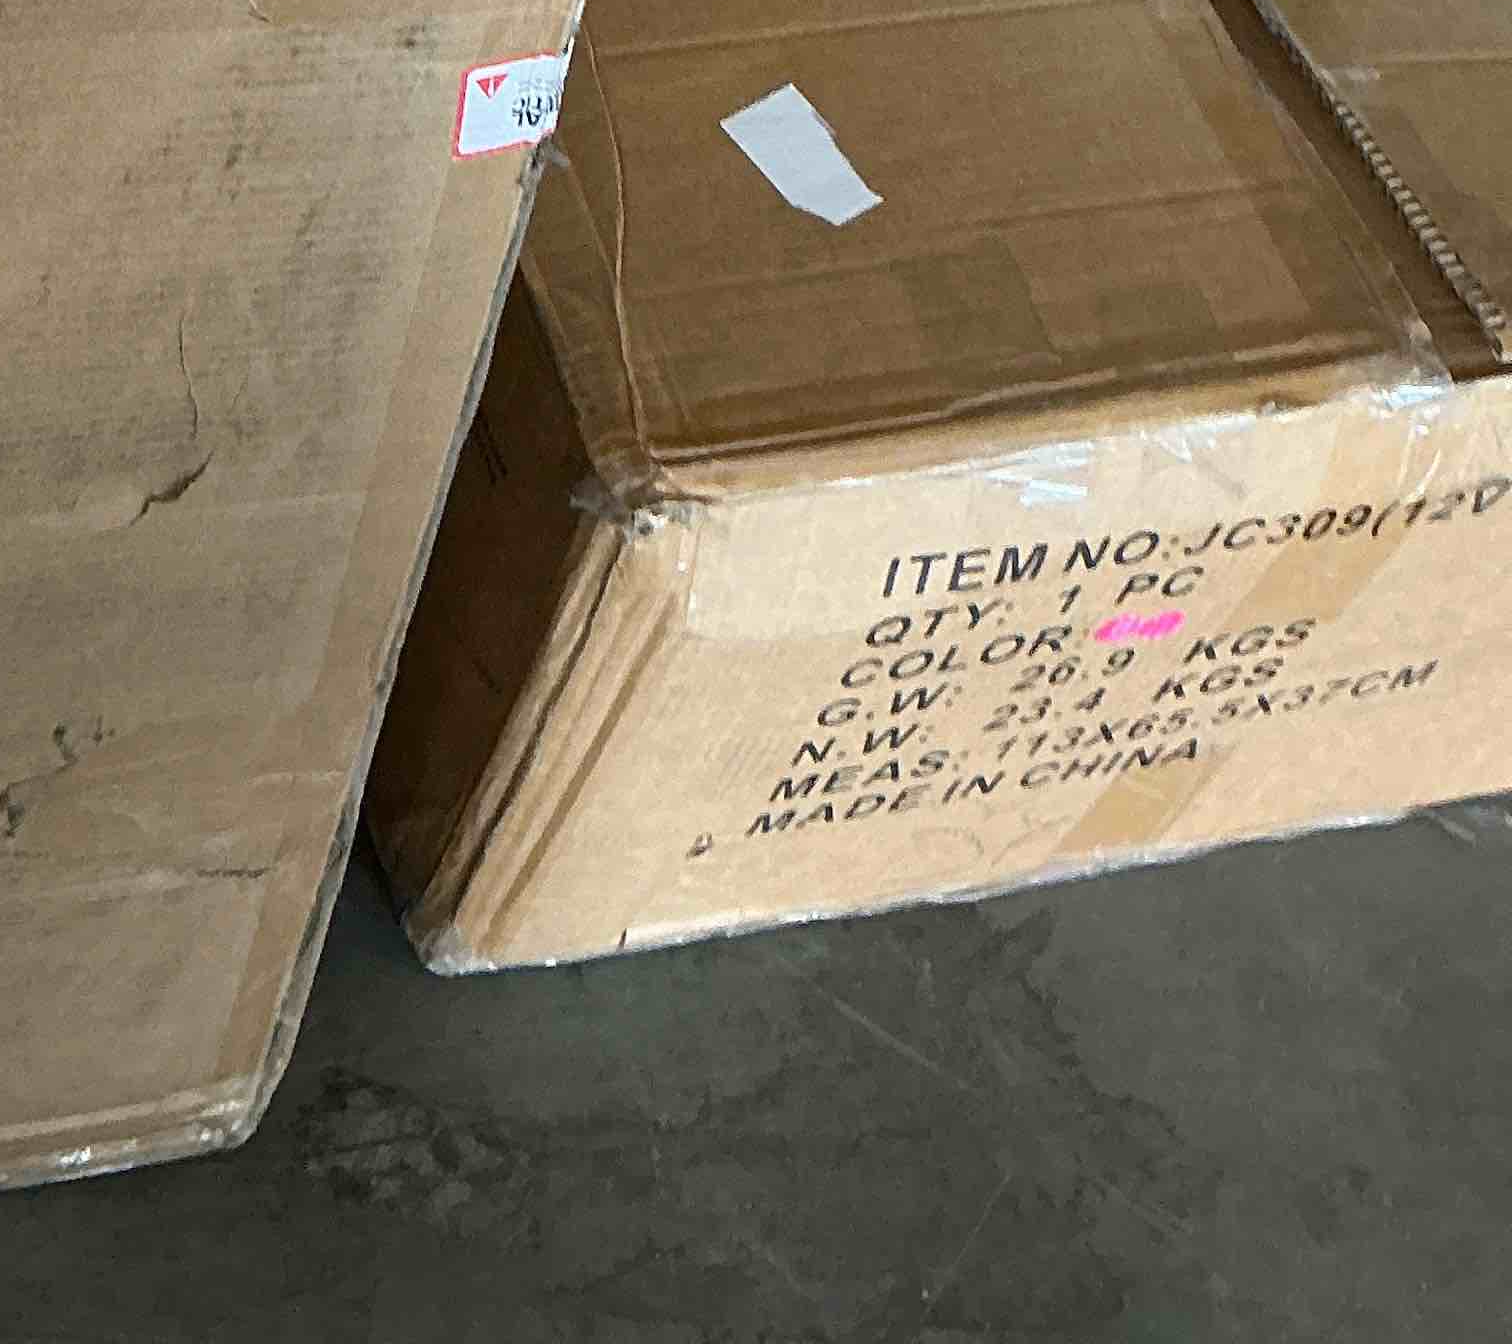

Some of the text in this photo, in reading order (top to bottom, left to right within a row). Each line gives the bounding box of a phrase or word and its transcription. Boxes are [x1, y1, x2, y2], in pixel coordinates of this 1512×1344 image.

[866, 566, 1204, 648] QTY: 1 PC
[883, 542, 1048, 597] ITEM
[792, 657, 1284, 768] N.W: 23.4 KGS
[817, 617, 1317, 727] G.W: 26.9 KGS
[745, 737, 1198, 837] MADE IN CHINA
[769, 749, 969, 803] MEAS:
